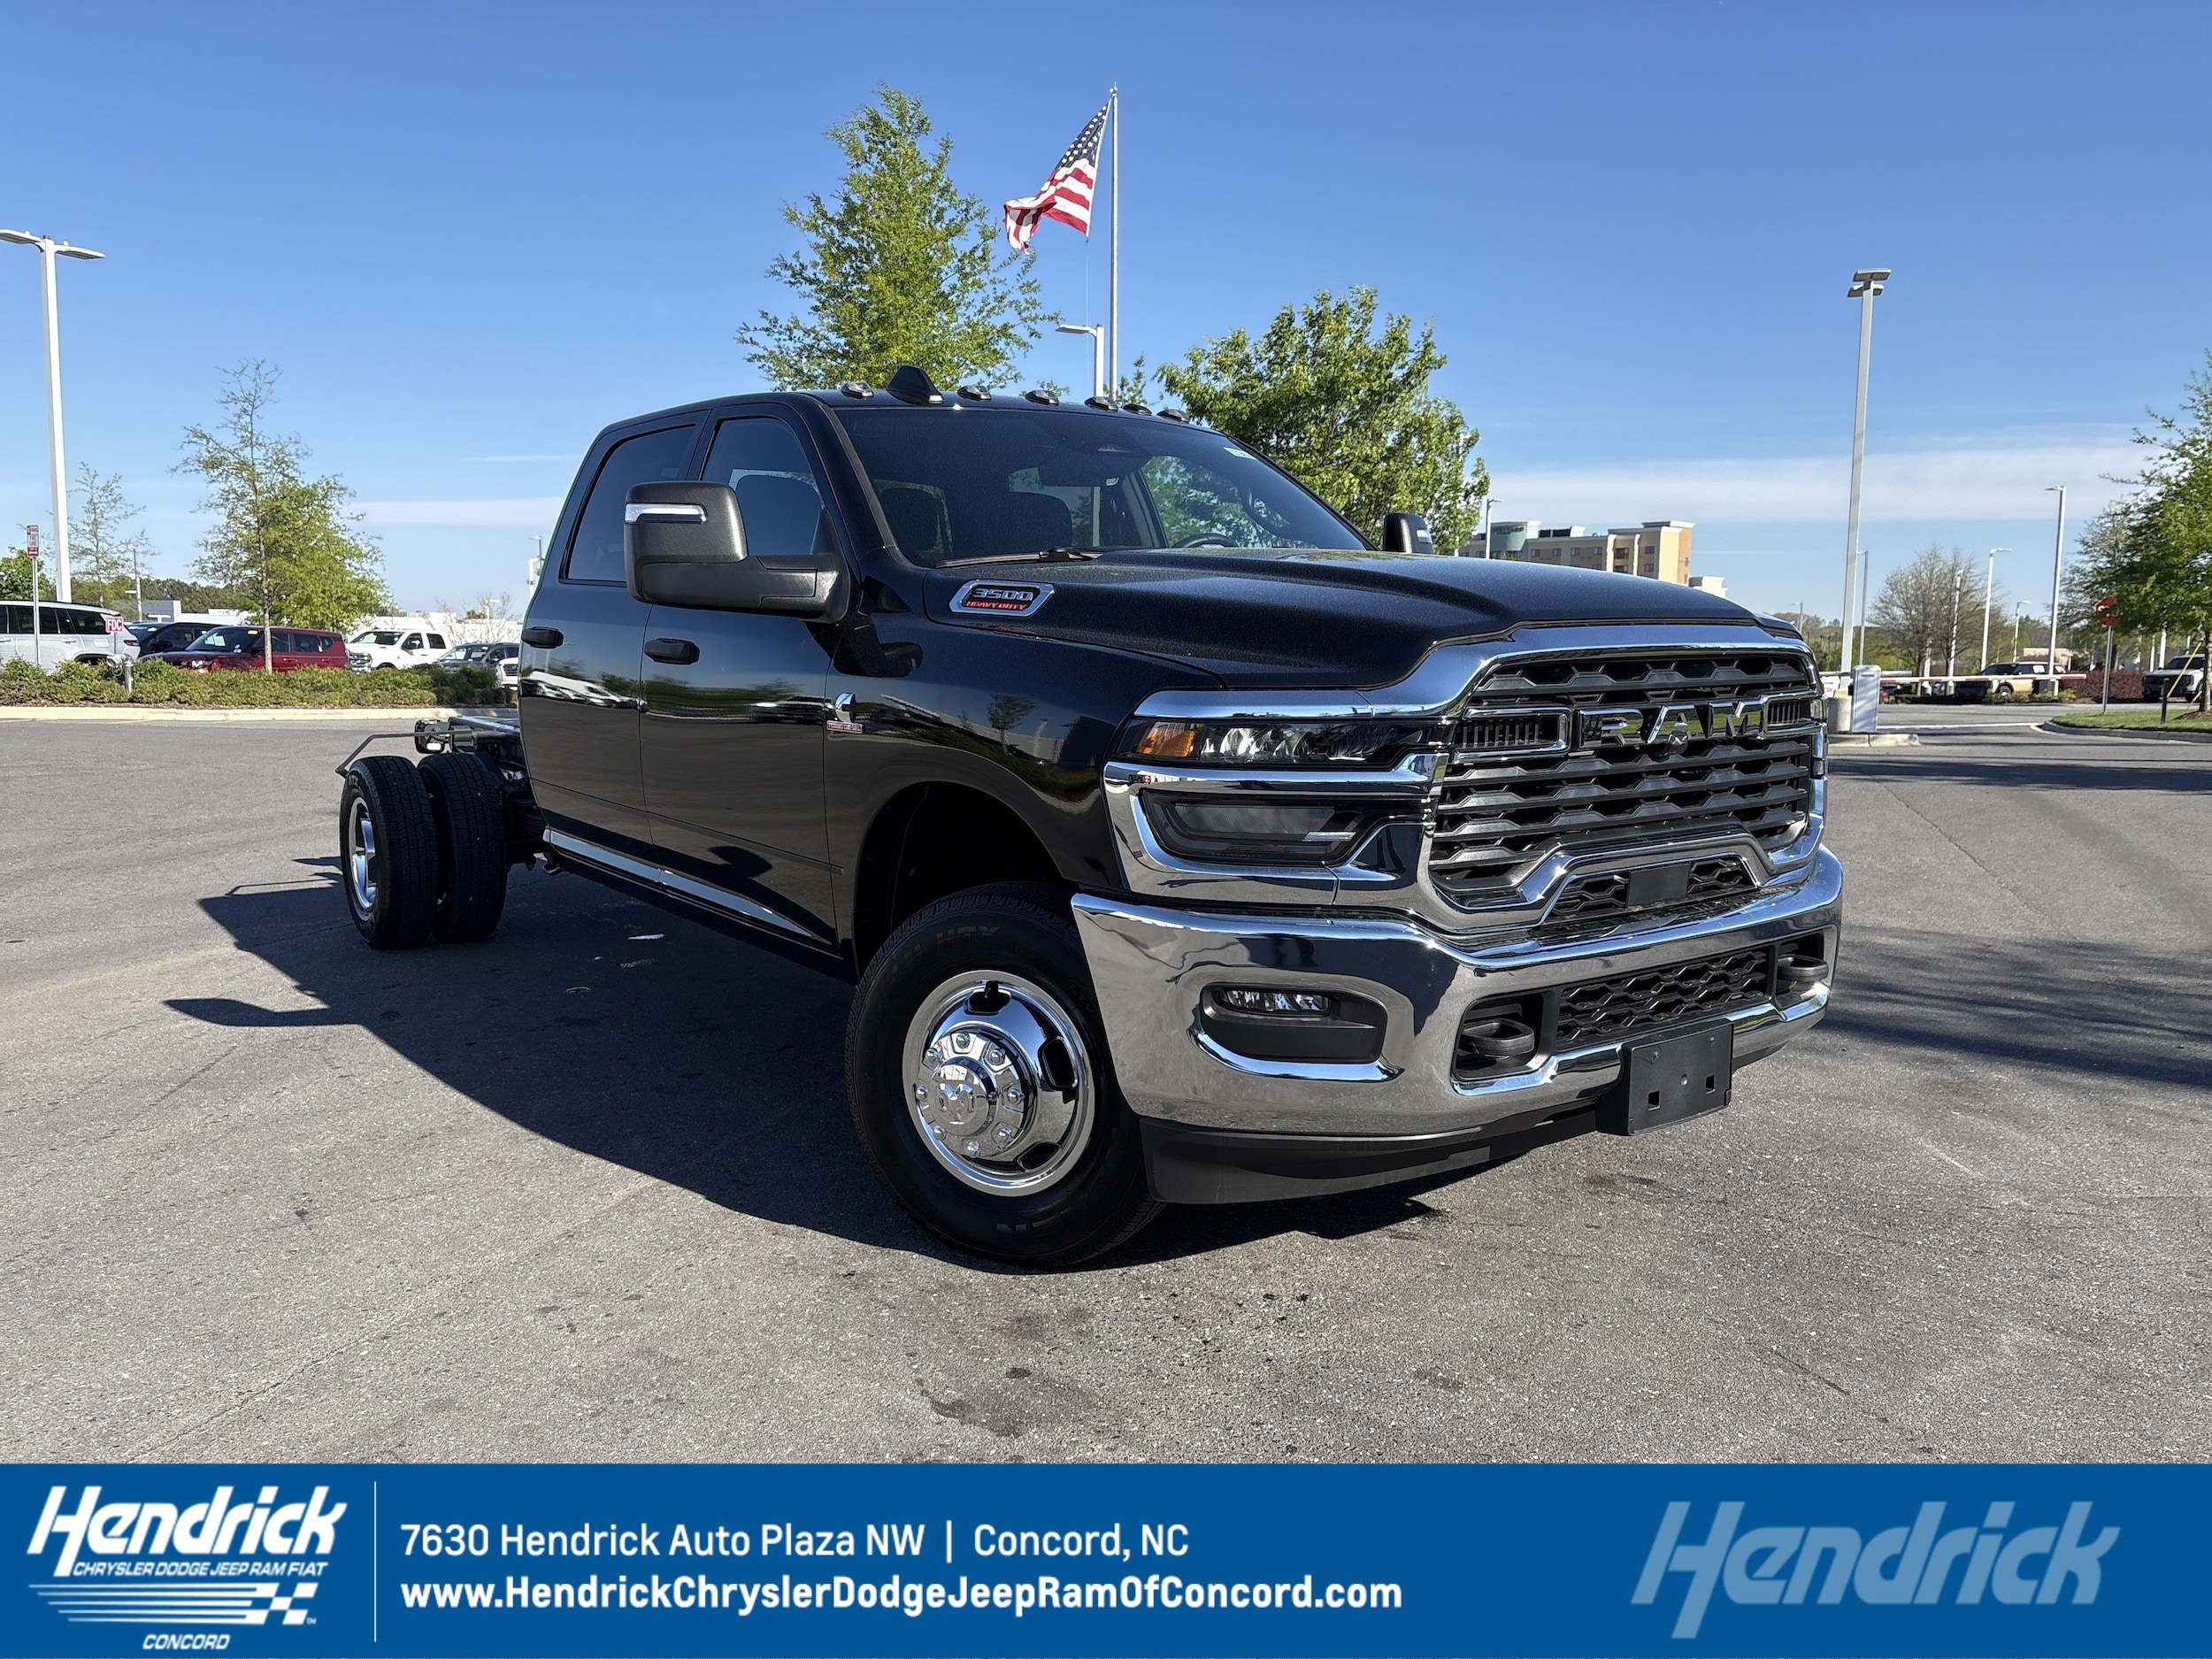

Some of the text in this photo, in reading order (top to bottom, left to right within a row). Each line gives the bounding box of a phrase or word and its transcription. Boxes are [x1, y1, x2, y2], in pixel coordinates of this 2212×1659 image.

[973, 588, 1034, 602] 3500
[107, 618, 123, 631] FDC
[1573, 700, 1763, 750] RAM
